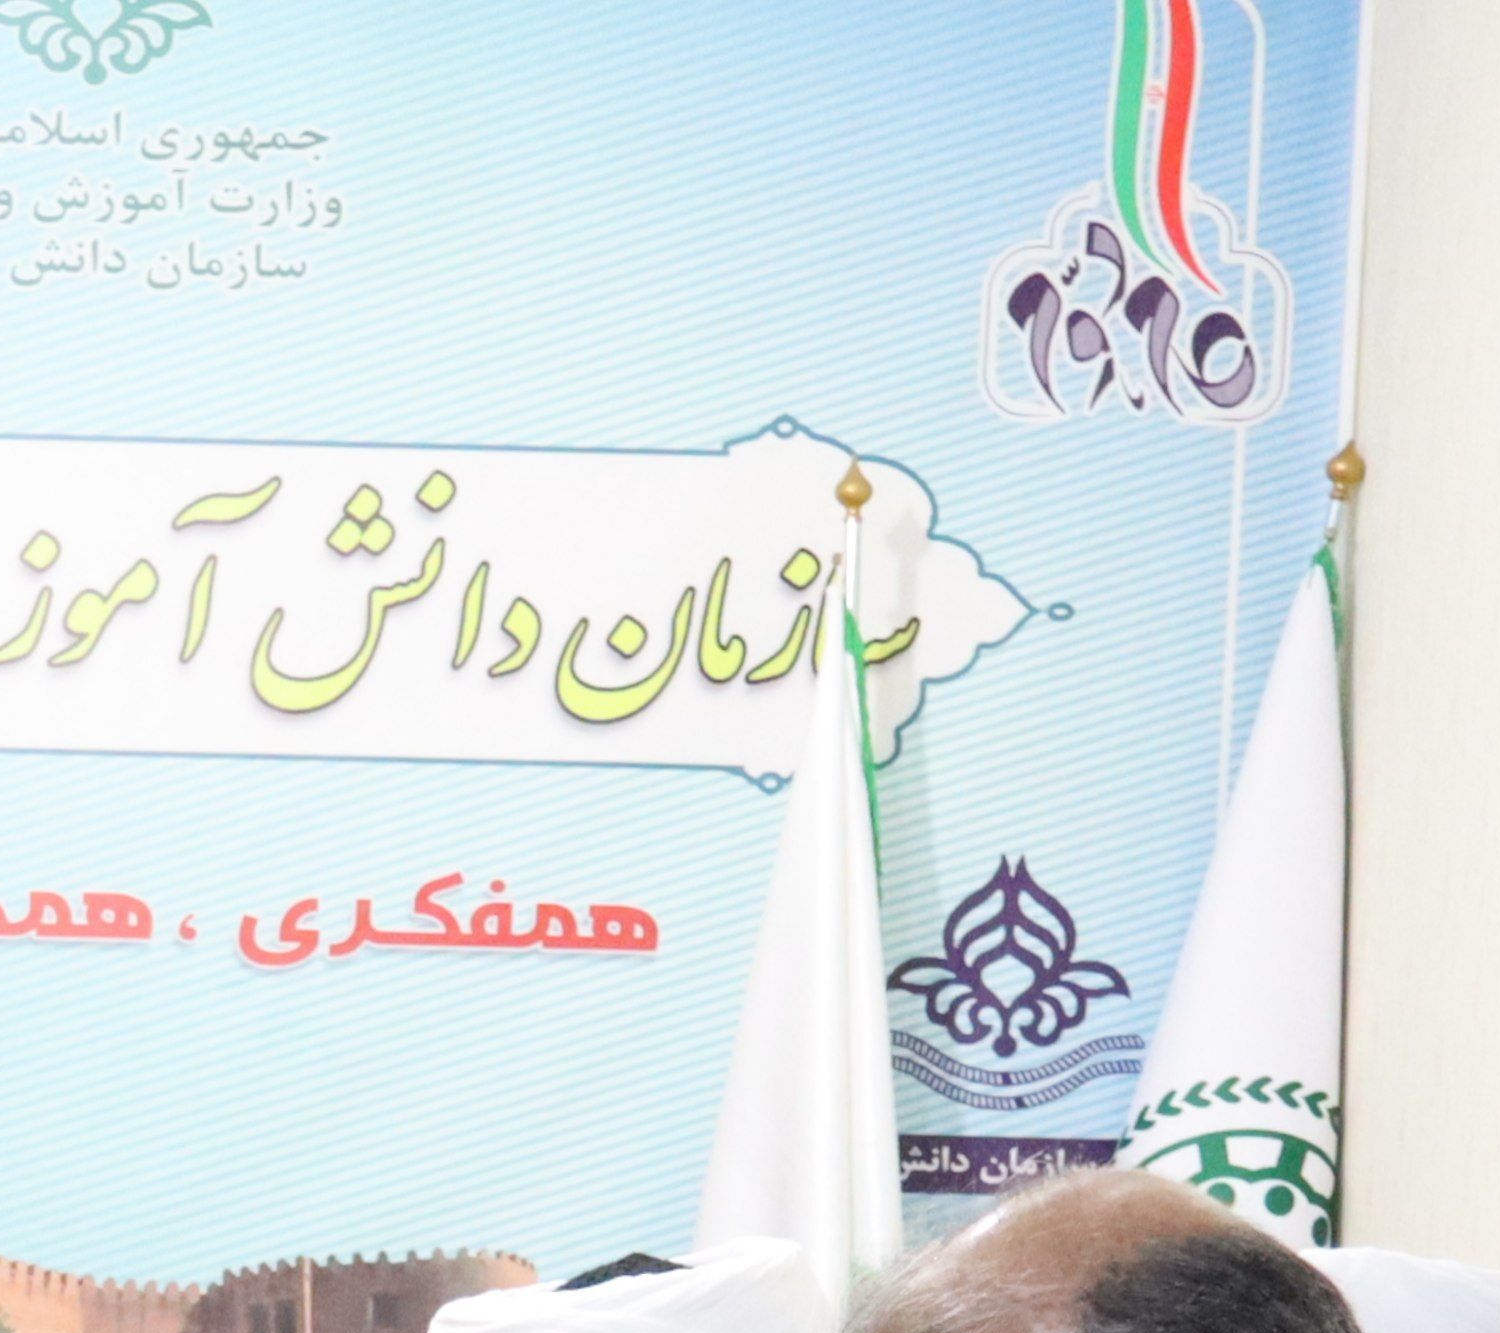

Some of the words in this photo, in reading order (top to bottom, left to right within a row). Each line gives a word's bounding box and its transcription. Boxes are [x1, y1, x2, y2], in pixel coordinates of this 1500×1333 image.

[139, 123, 331, 162] جمهوری
[31, 168, 189, 224] آموزش
[208, 178, 345, 228] وزارت
[10, 239, 128, 288] دانش
[146, 242, 309, 290] سازمان
[252, 468, 543, 716] دانش
[237, 869, 660, 968] همفکری
